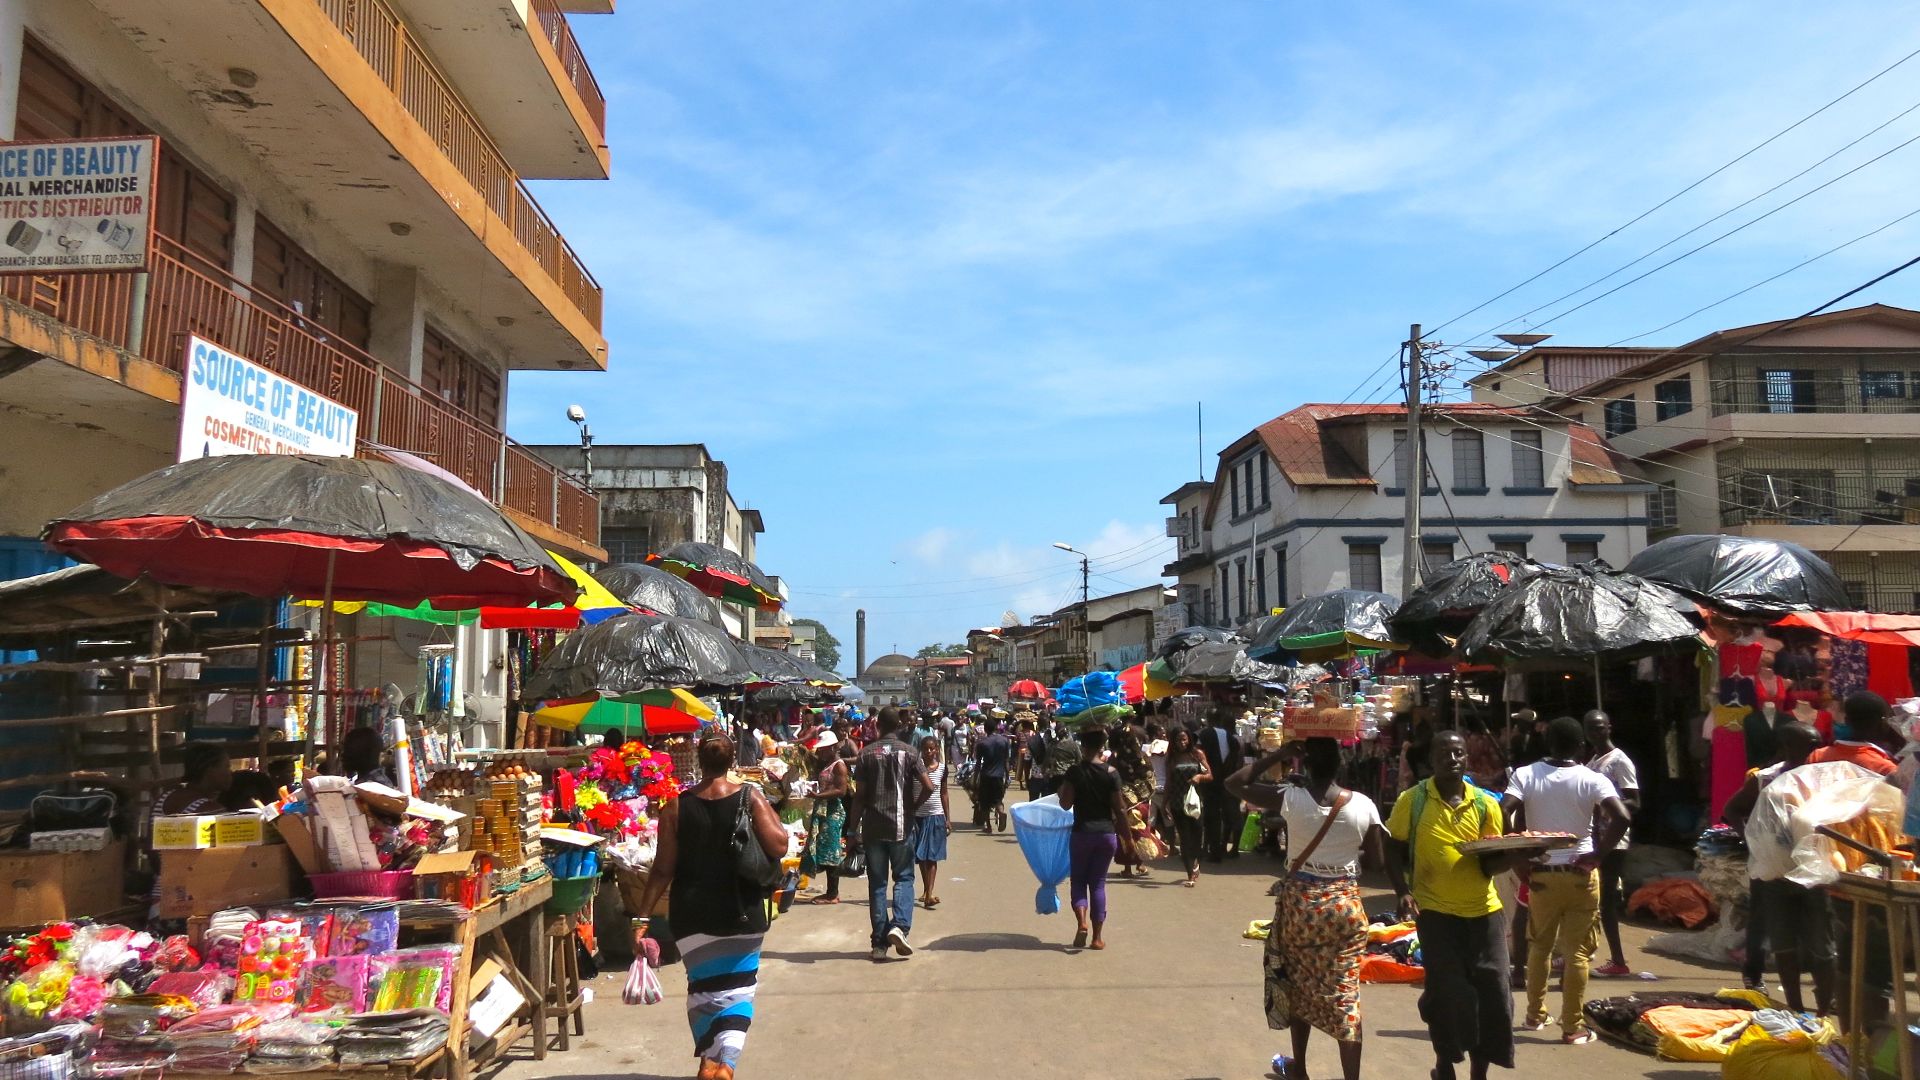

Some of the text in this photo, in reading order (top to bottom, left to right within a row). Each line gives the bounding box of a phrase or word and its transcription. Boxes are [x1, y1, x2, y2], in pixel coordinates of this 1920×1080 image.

[0, 145, 142, 178] CE OF BEAUTY
[29, 177, 138, 196] MERCHANDISE
[0, 196, 143, 219] TICS DISTRIBUTOR
[193, 344, 355, 447] SOURCE OF BEAUTY
[204, 415, 271, 455] COSMETICS
[244, 411, 311, 448] GENERAL MERCHANDISE
